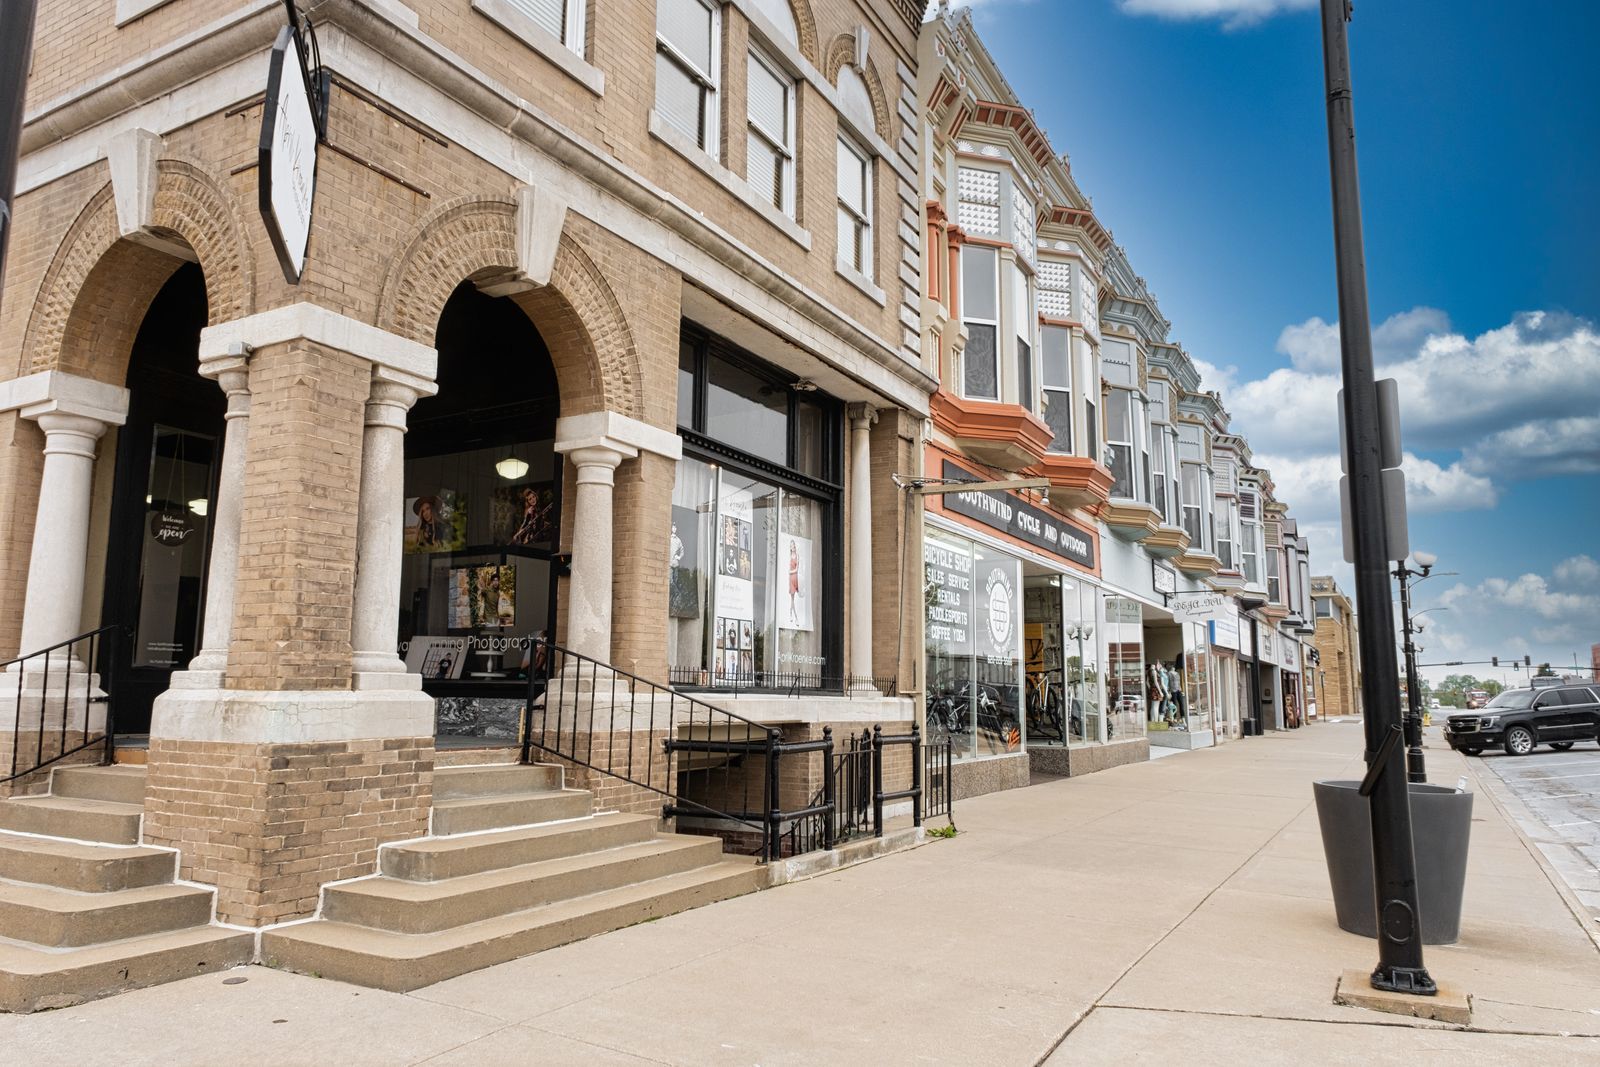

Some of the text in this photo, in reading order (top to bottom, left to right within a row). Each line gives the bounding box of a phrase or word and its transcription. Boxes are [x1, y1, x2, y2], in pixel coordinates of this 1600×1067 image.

[958, 490, 1087, 557] SOUTHWIND CYCLE AND OUTDOOR
[924, 544, 972, 574] BICYCLE SHOP
[926, 567, 970, 591] SALES SERVICE
[937, 588, 961, 606] RENTALS
[928, 605, 968, 626] PADDLESPORTS
[931, 625, 967, 642] COFFEE YOGA
